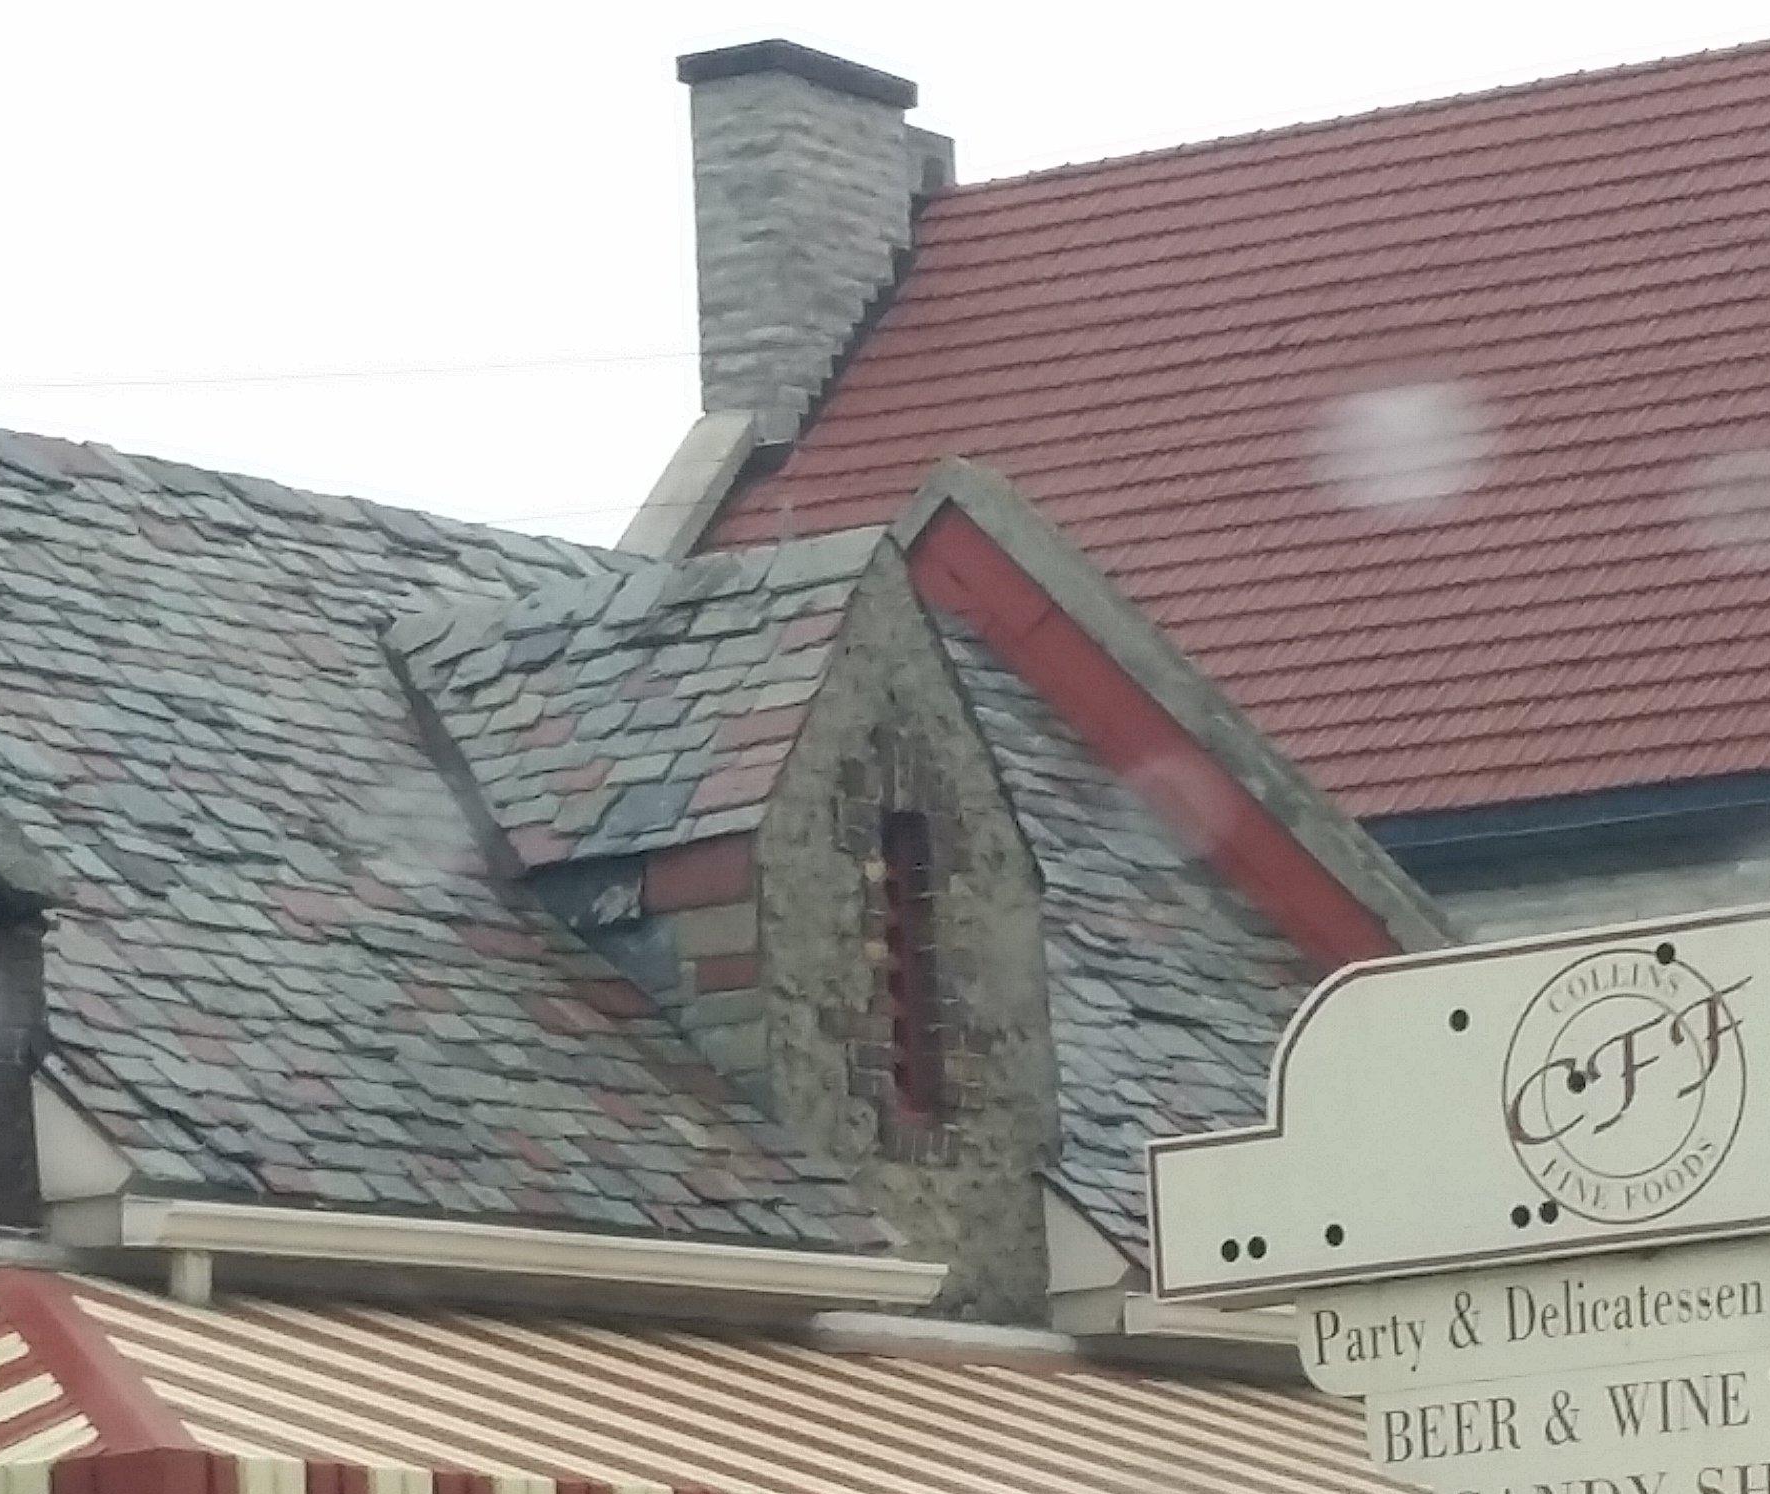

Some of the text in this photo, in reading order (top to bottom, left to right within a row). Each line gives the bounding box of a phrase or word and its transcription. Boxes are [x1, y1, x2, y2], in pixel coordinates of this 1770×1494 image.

[1549, 963, 1679, 1013] COLLINS
[1625, 1137, 1713, 1211] FOODS
[1312, 1309, 1426, 1372] Party
[1448, 1290, 1482, 1349] &
[1505, 1280, 1765, 1343] Delicatessen
[1382, 1397, 1521, 1463] BEER
[1545, 1389, 1583, 1446] &
[1605, 1371, 1750, 1438] WINE
